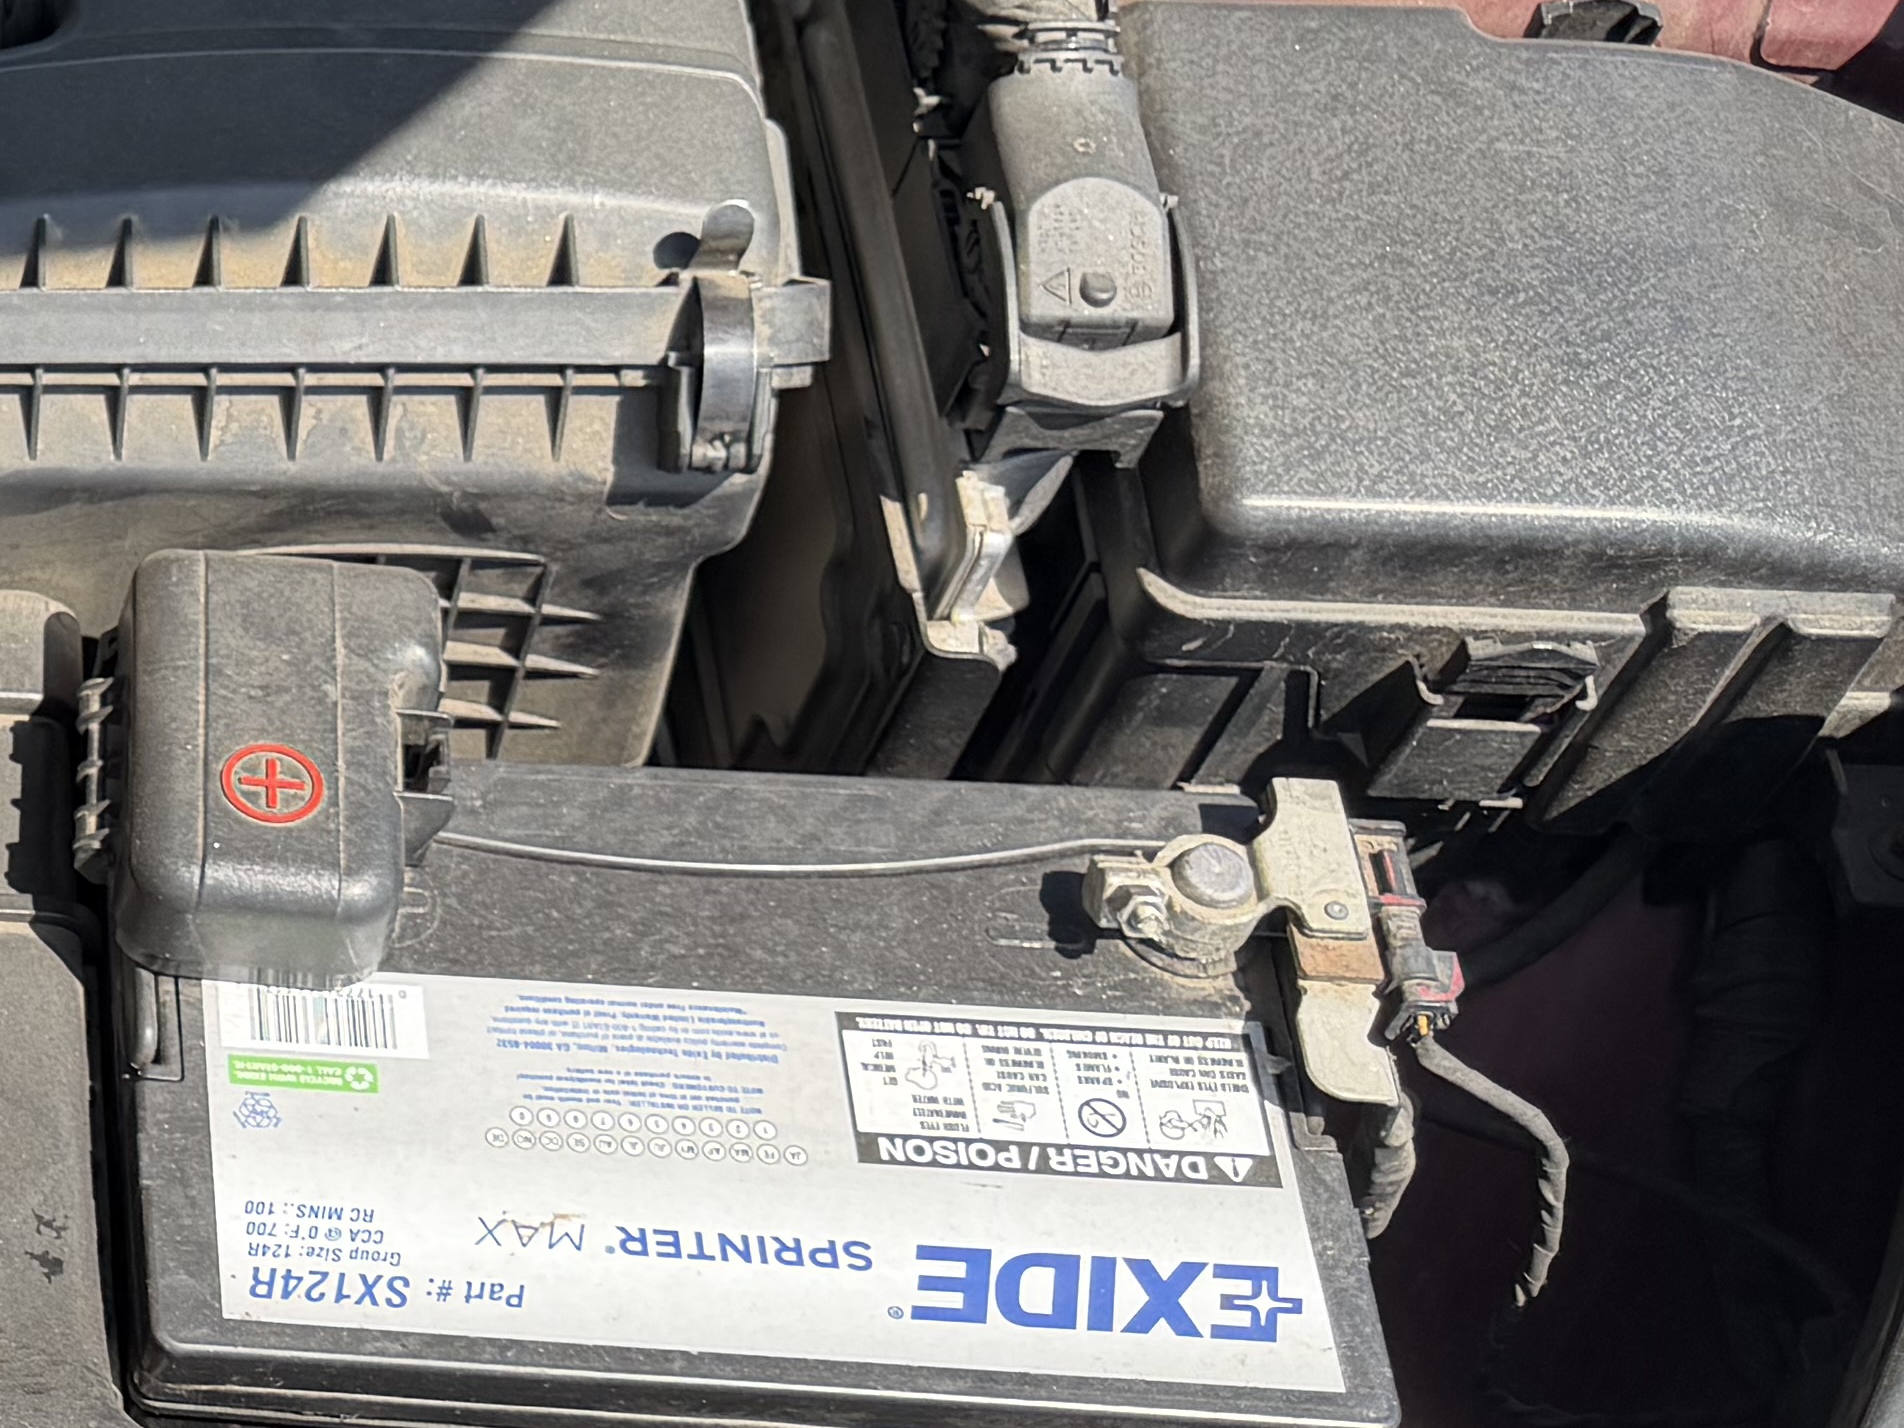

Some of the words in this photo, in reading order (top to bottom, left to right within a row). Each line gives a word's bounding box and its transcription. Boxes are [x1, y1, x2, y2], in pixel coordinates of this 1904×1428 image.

[556, 1042, 570, 1052] GA
[877, 1136, 1021, 1166] POISON
[1029, 1147, 1040, 1170] /
[1048, 1147, 1209, 1180] DANGER
[245, 1200, 274, 1215] 100
[282, 1202, 343, 1221] MINS.:
[350, 1207, 374, 1223] RC
[246, 1221, 277, 1237] 700
[324, 1226, 342, 1241] @
[349, 1228, 384, 1244] CCA
[474, 1216, 585, 1252] MAX
[247, 1242, 291, 1259] 124R
[299, 1246, 343, 1263] Size:
[349, 1247, 401, 1267] Group
[615, 1224, 874, 1272] SPRINTER
[248, 1266, 410, 1309] SX124R
[426, 1278, 453, 1302] #:
[464, 1281, 524, 1308] Part
[911, 1243, 1302, 1343] EXIDE
